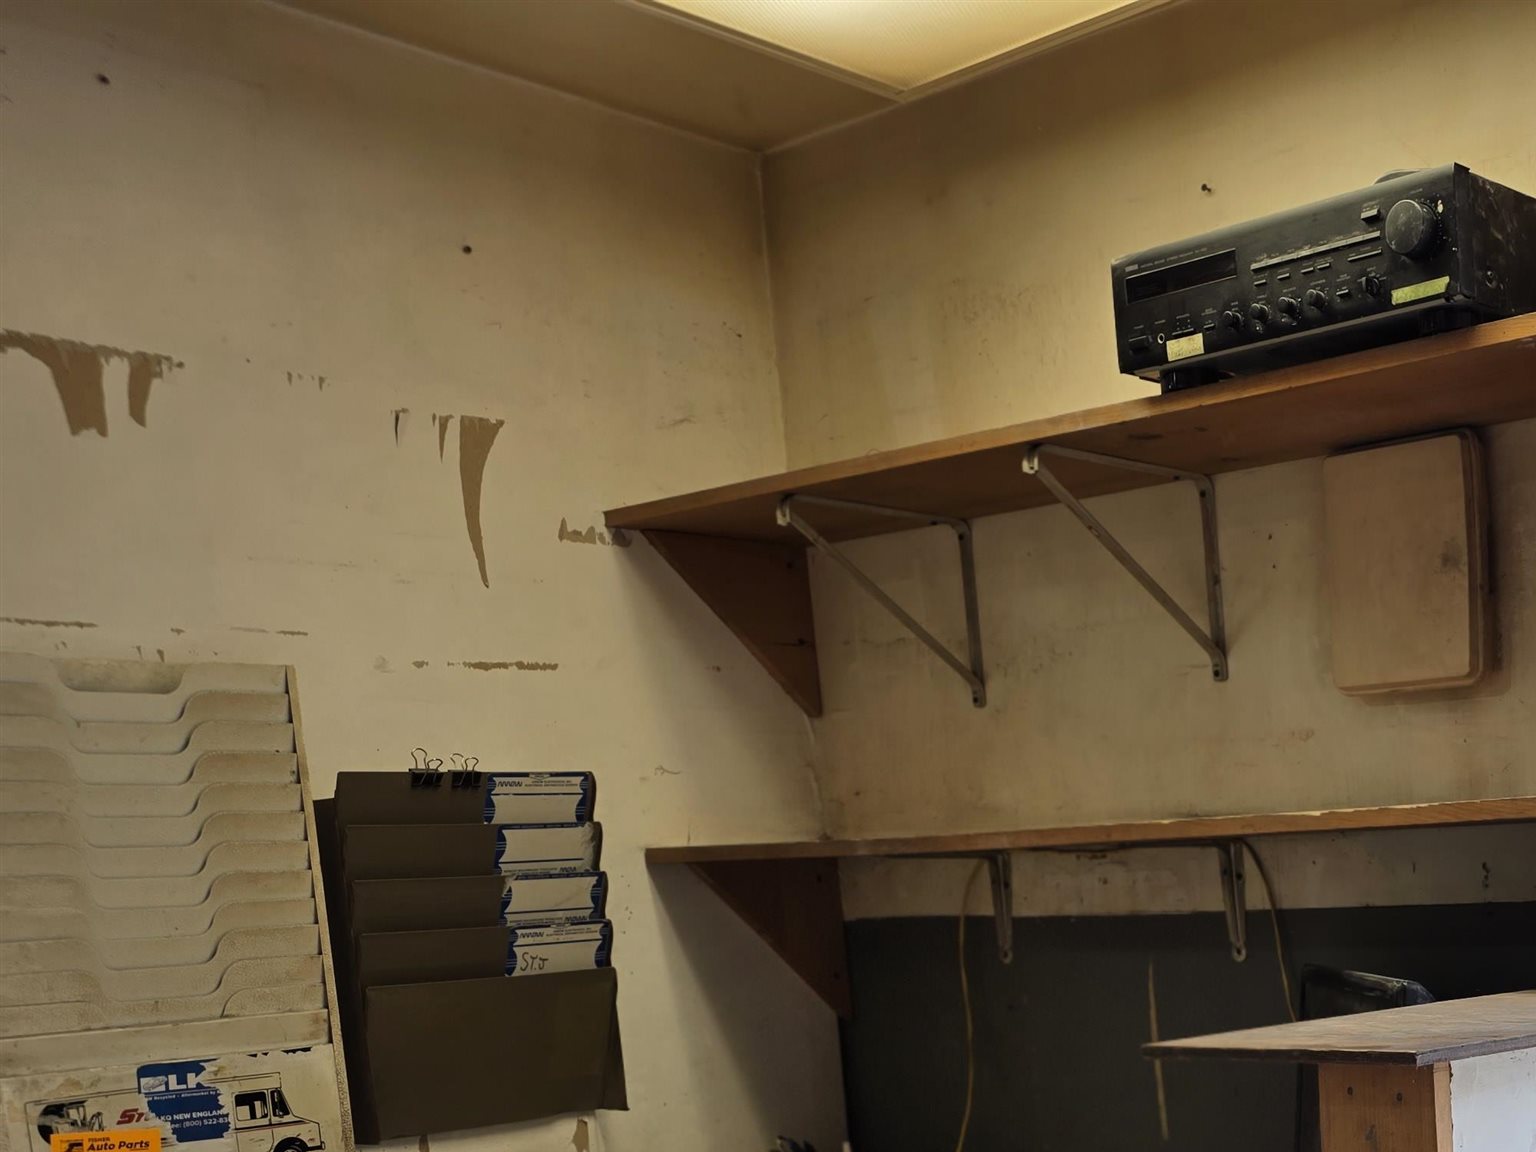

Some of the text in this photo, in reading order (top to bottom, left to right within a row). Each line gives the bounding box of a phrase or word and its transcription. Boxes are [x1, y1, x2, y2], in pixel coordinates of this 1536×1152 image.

[173, 1112, 191, 1121] NEW
[183, 1119, 202, 1129] (800)
[87, 1140, 150, 1152] Auto Parts
